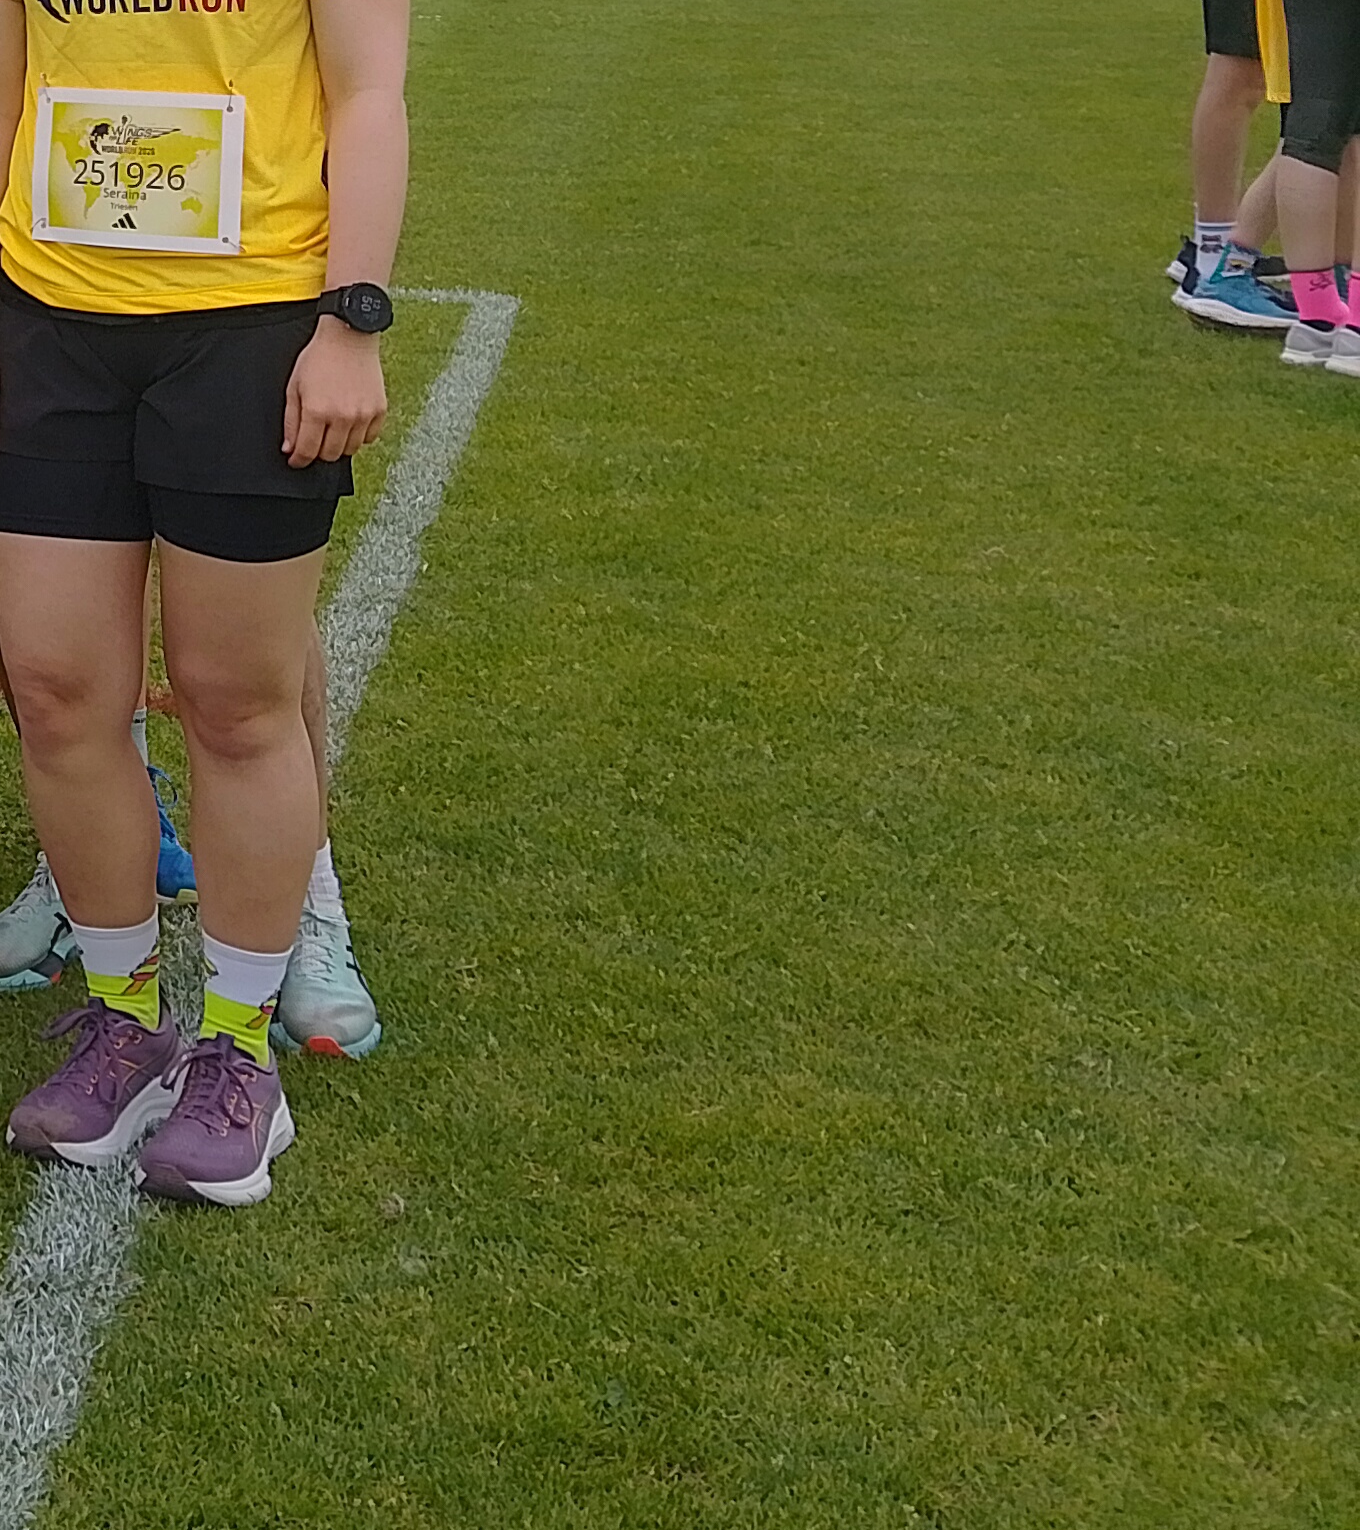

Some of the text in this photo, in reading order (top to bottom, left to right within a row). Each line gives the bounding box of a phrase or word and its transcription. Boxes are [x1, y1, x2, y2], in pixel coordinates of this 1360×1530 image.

[73, 159, 186, 191] 251926
[103, 188, 147, 201] Seraina
[361, 295, 373, 312] 50
